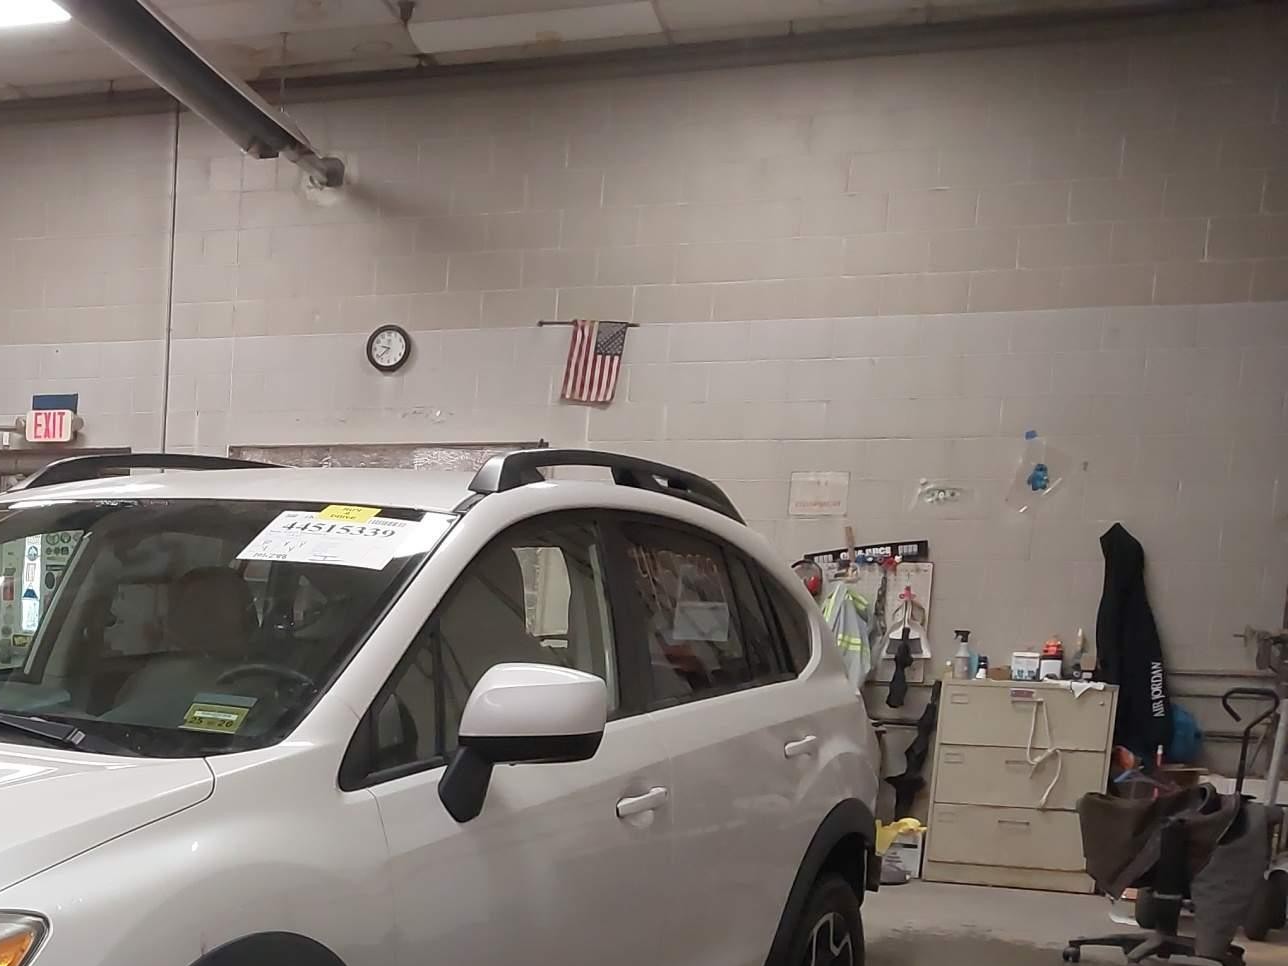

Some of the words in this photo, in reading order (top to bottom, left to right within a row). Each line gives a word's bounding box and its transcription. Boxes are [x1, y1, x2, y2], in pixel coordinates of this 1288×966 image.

[34, 412, 65, 438] EXIT
[281, 521, 396, 538] 44515339
[1150, 661, 1165, 700] JORDAN
[1152, 700, 1165, 717] AIR
